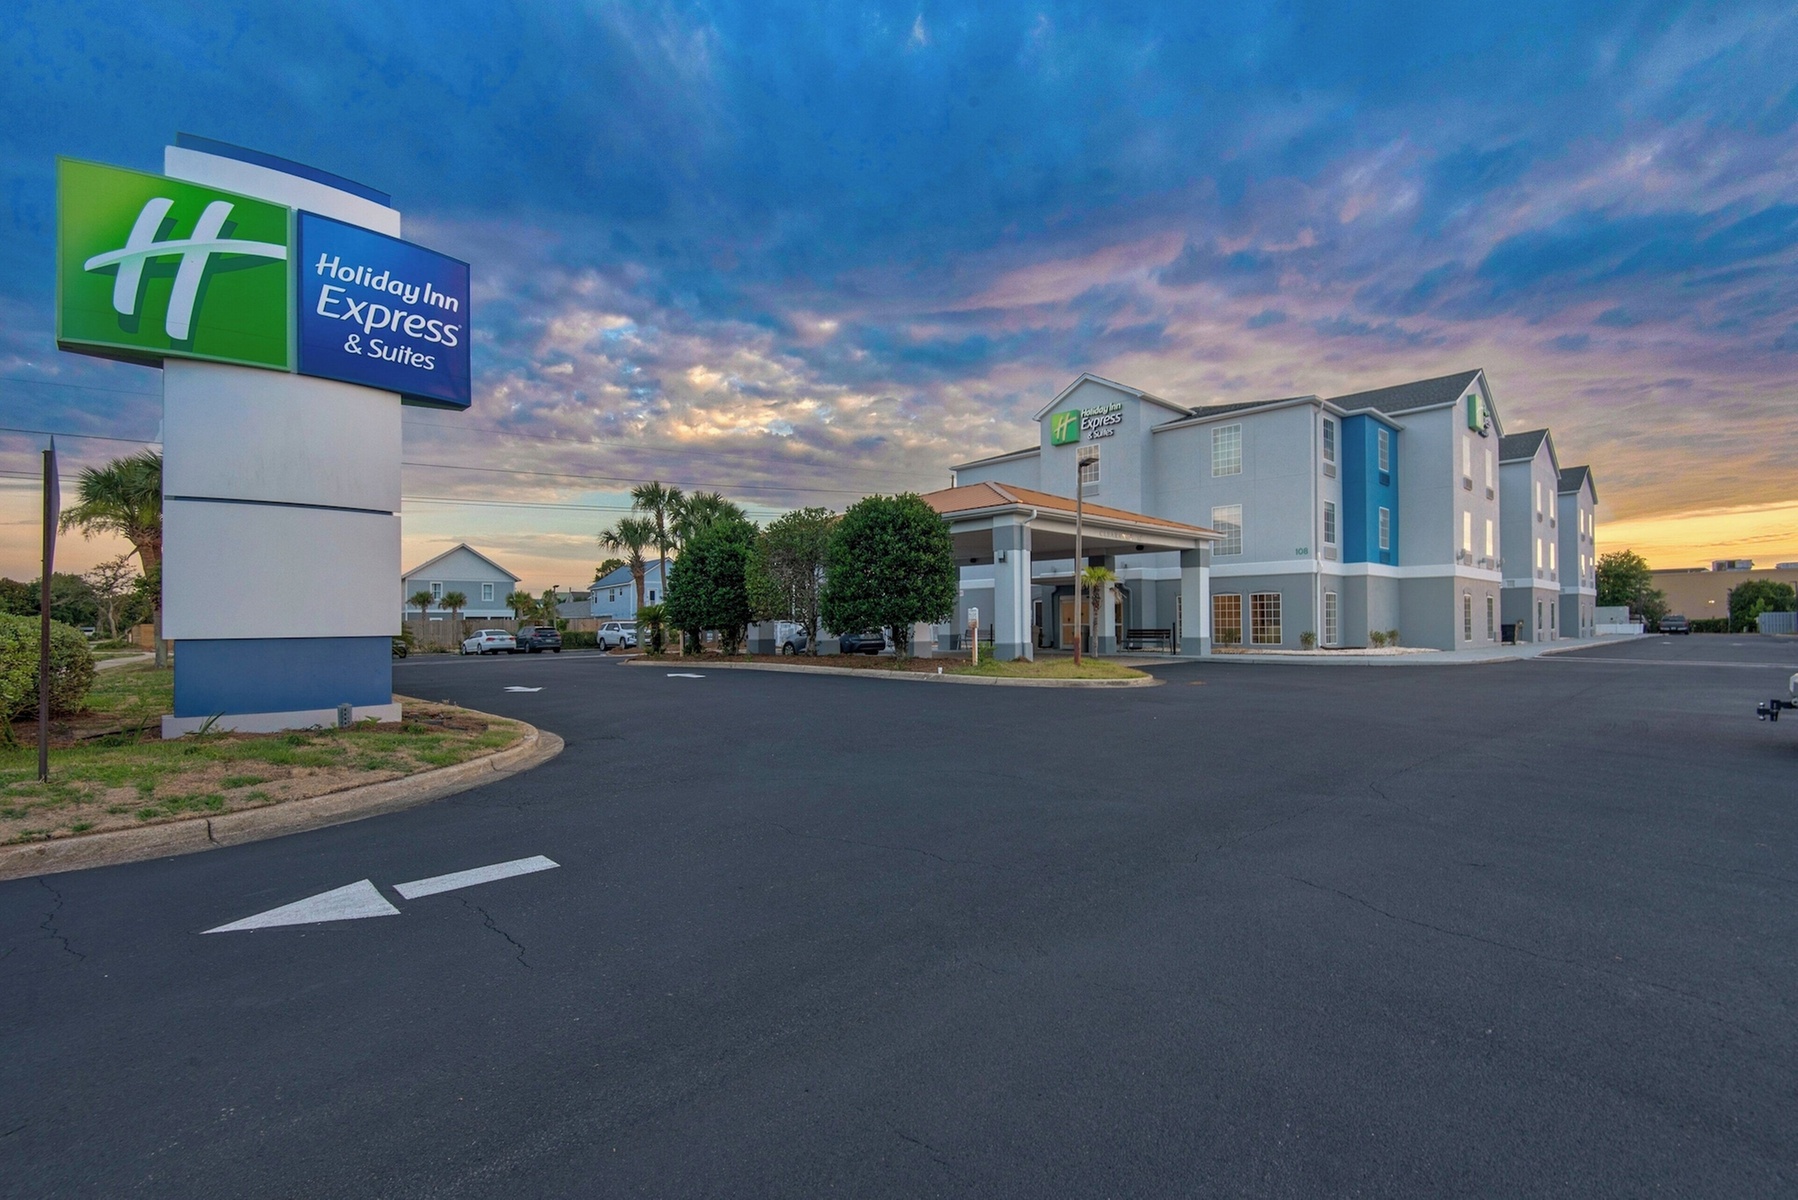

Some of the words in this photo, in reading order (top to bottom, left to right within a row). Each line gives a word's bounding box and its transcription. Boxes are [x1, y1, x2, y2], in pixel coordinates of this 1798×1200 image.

[315, 253, 420, 304] Holiday
[423, 282, 459, 313] Inn
[316, 284, 459, 347] Express
[344, 333, 362, 355] &
[367, 338, 436, 371] Suites
[1081, 405, 1108, 418] Holiday
[1109, 402, 1122, 412] Inn
[1081, 412, 1122, 431] Express
[1093, 428, 1115, 439] Suites
[1295, 547, 1309, 556] 108
